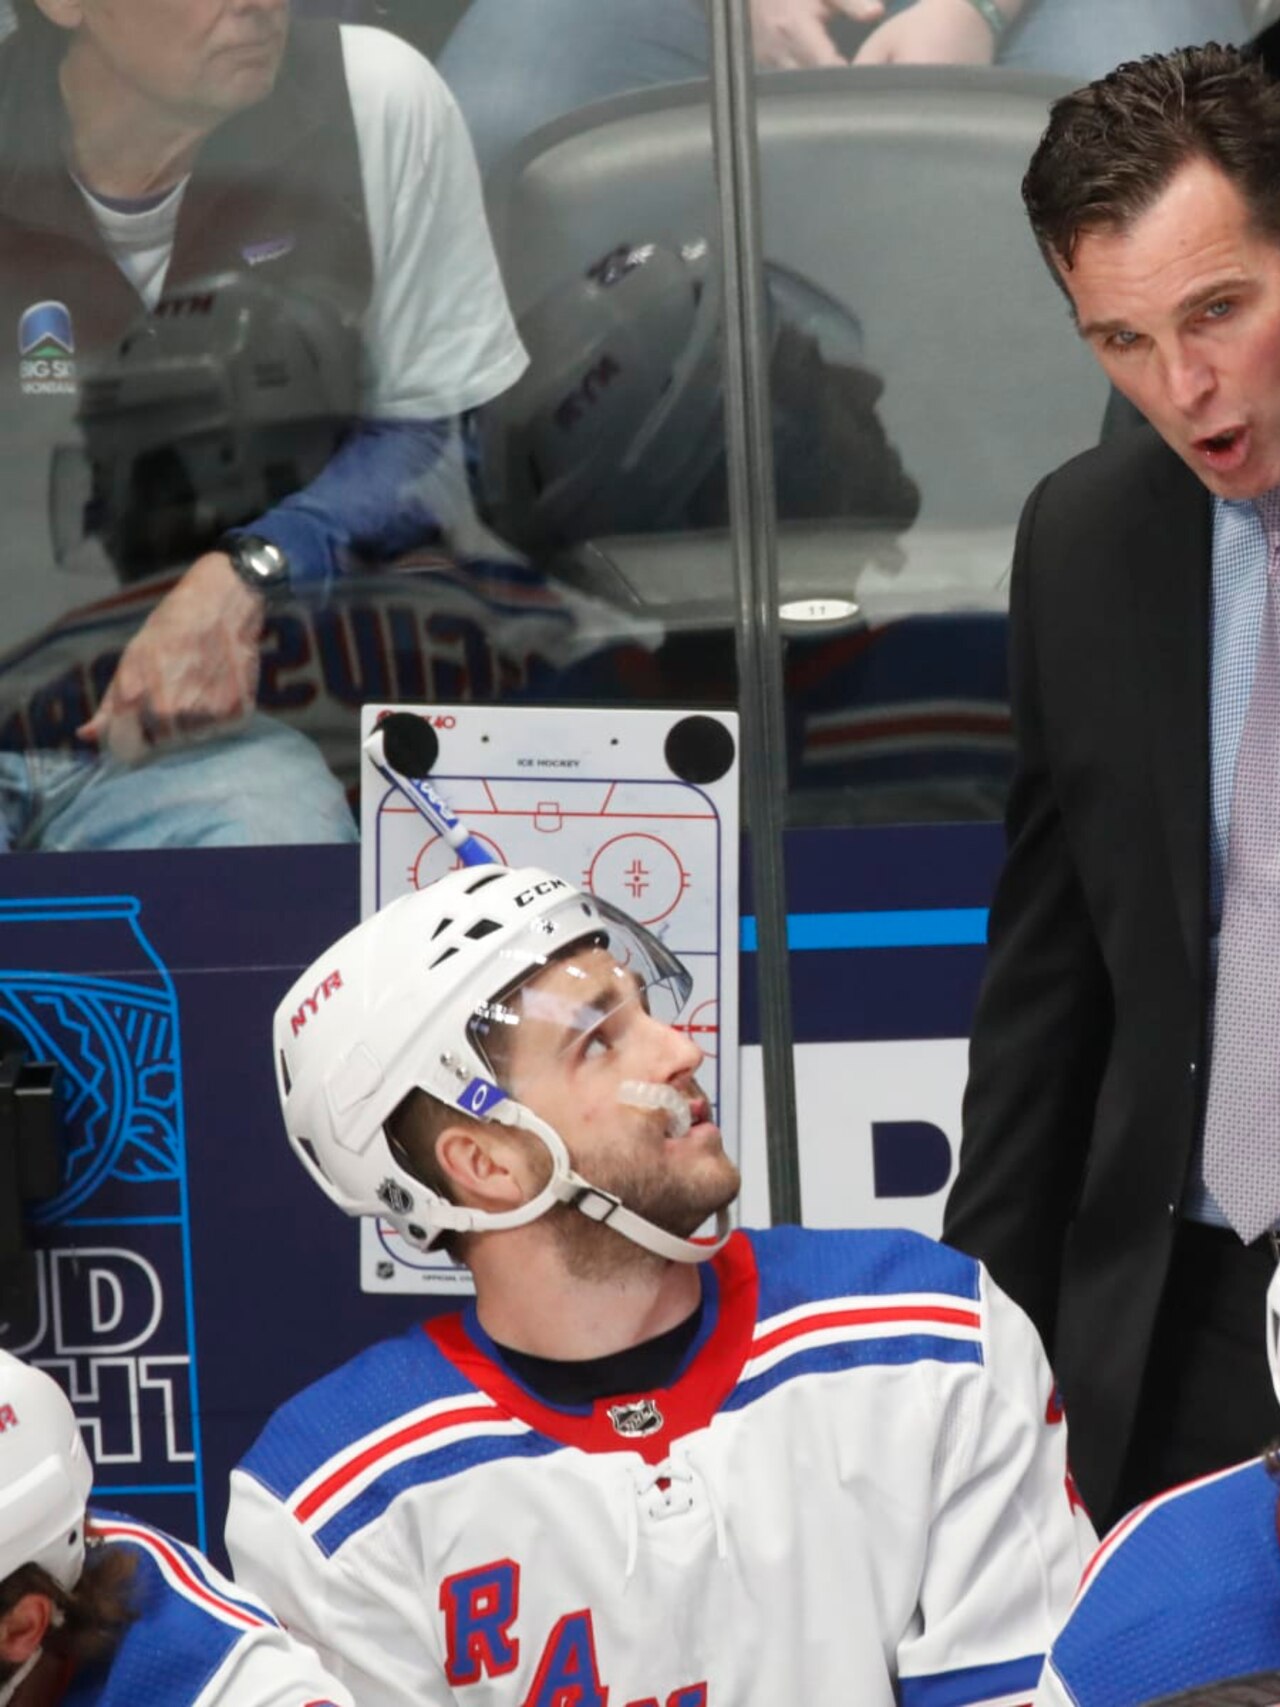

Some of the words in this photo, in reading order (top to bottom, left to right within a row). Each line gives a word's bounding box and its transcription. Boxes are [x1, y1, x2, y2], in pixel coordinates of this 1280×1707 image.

[517, 758, 533, 768] ICE
[537, 758, 581, 768] HOCKEY
[513, 878, 567, 908] CCM
[290, 969, 345, 1038] NYR
